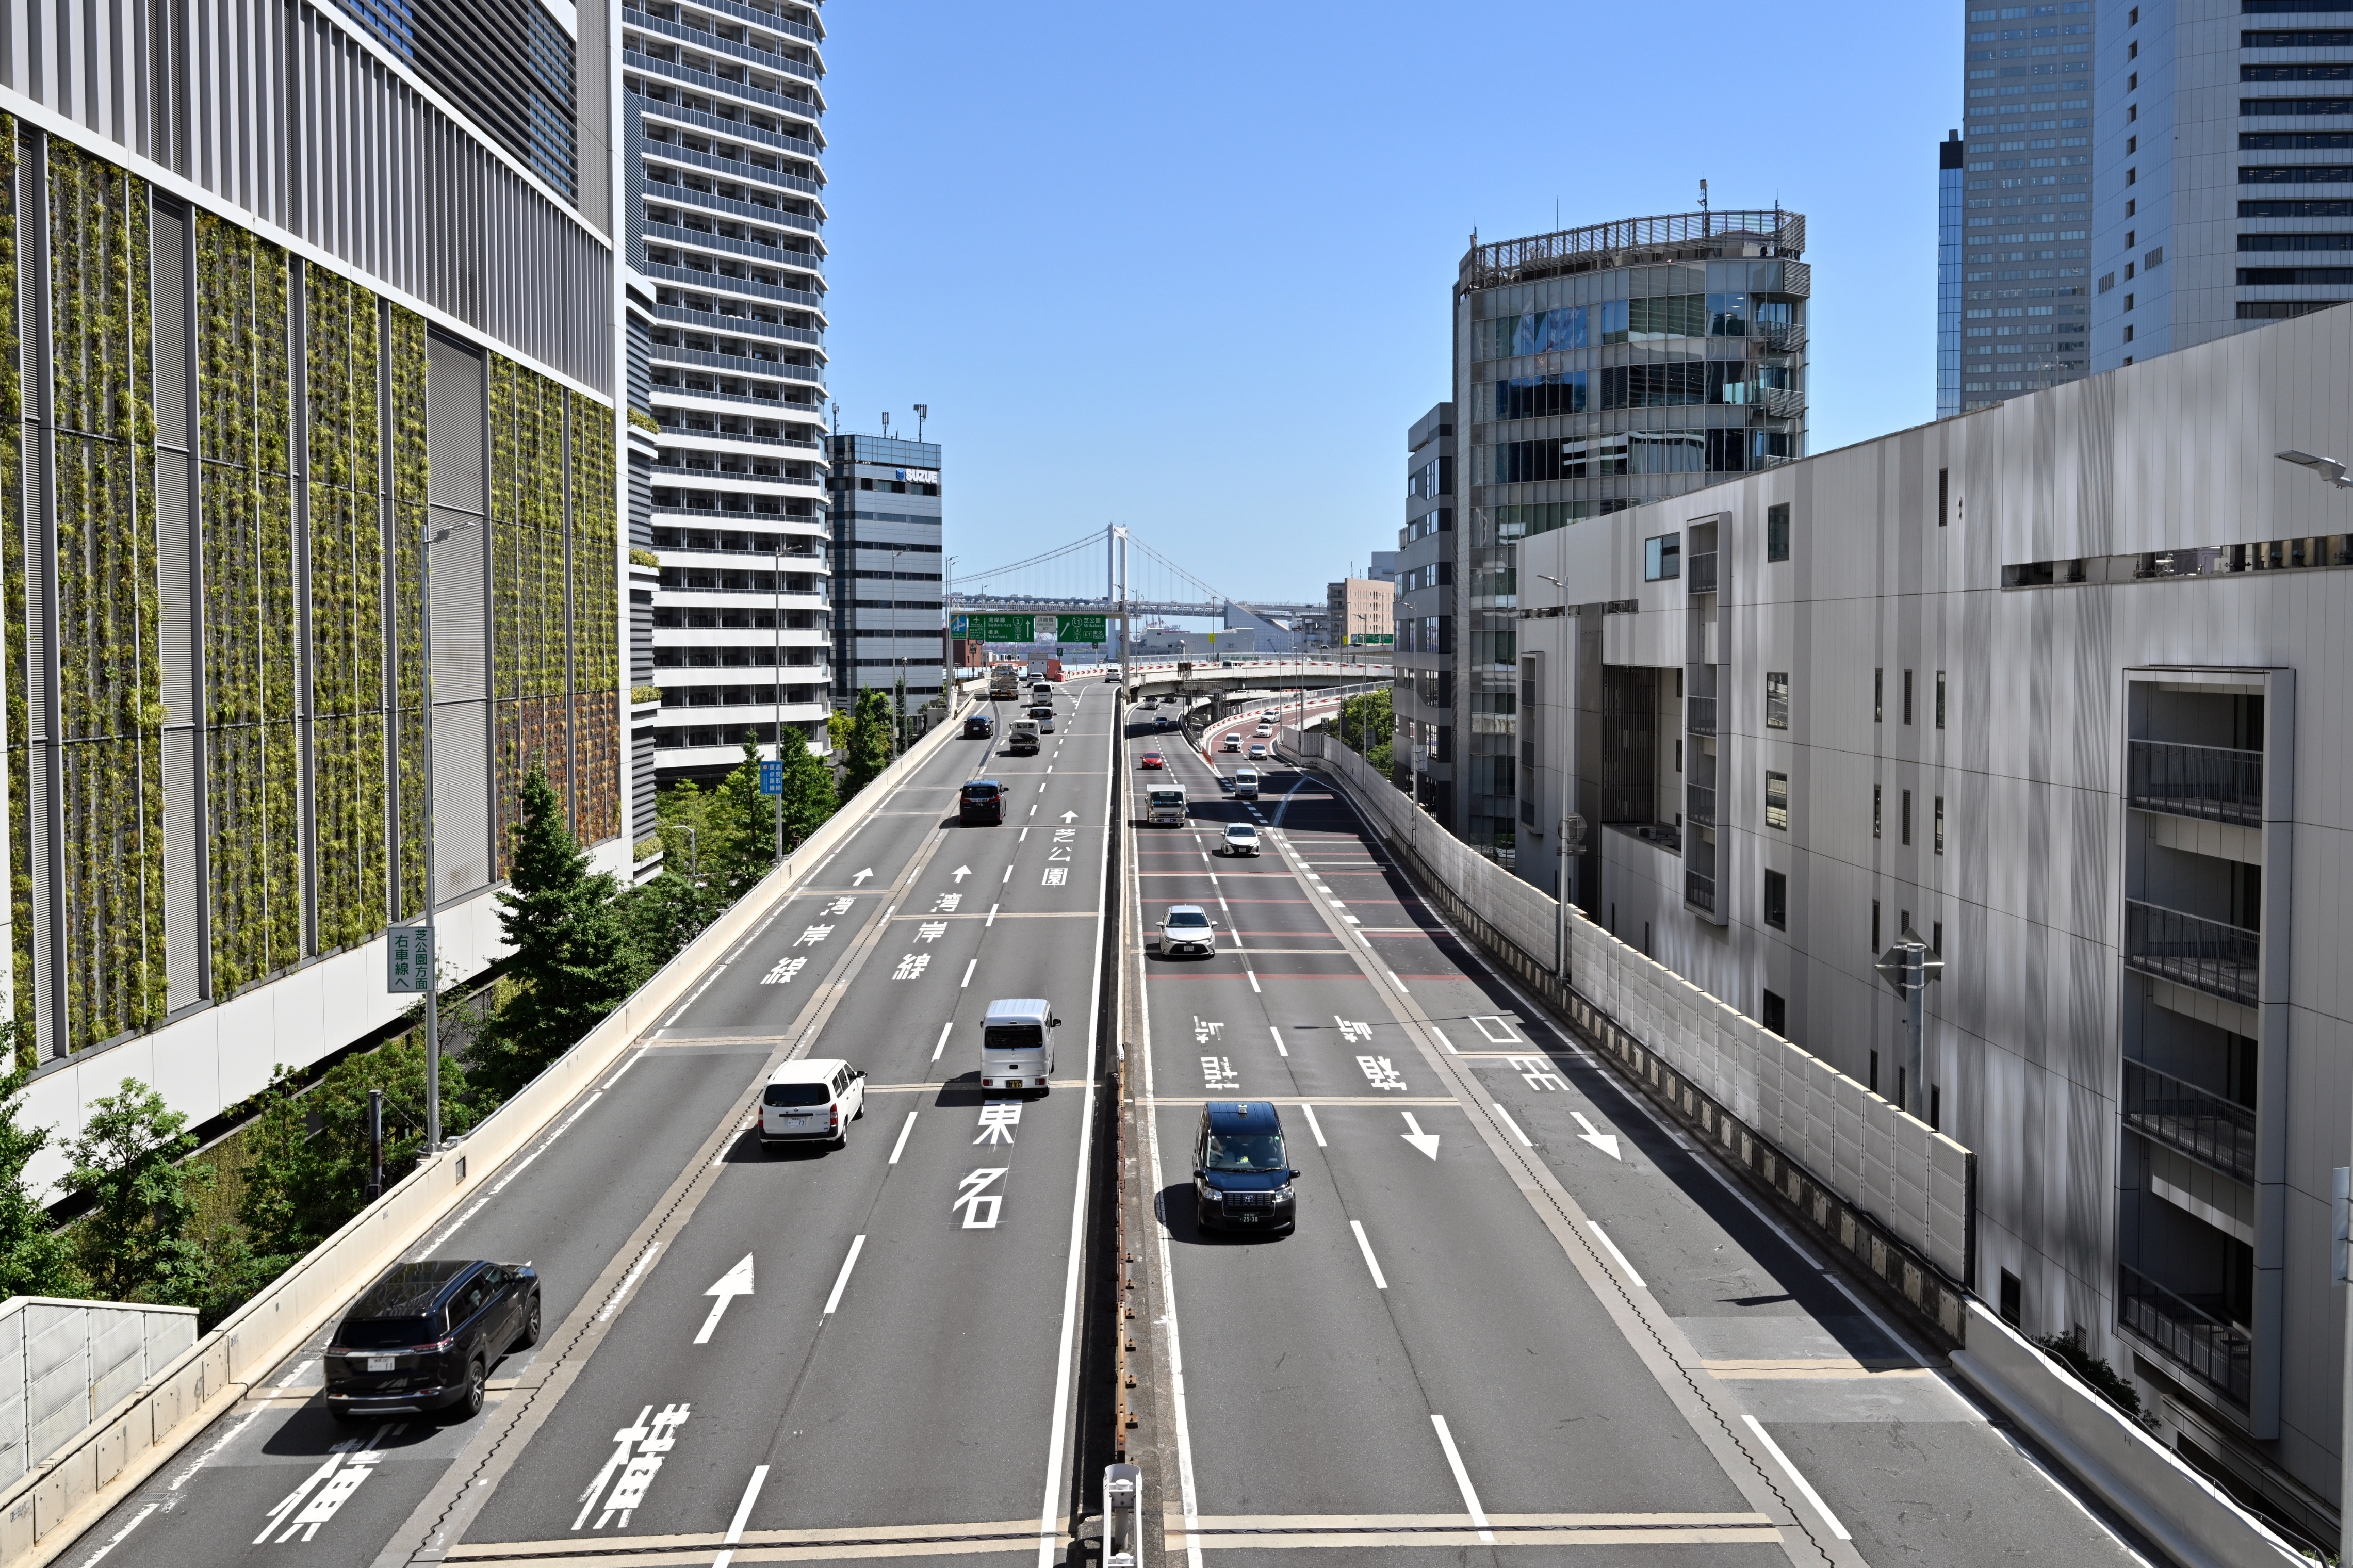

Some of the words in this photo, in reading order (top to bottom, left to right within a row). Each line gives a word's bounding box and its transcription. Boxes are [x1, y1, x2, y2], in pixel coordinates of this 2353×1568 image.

[906, 468, 937, 483] SUZUE
[1041, 829, 1076, 886] 芝公園
[395, 935, 409, 988] 右車線へ
[415, 929, 427, 990] 芝公園方面
[760, 895, 856, 984] 湾岸線
[892, 893, 962, 980] 湾岸線
[953, 1098, 1023, 1228] 東名
[571, 1403, 690, 1530] 横
